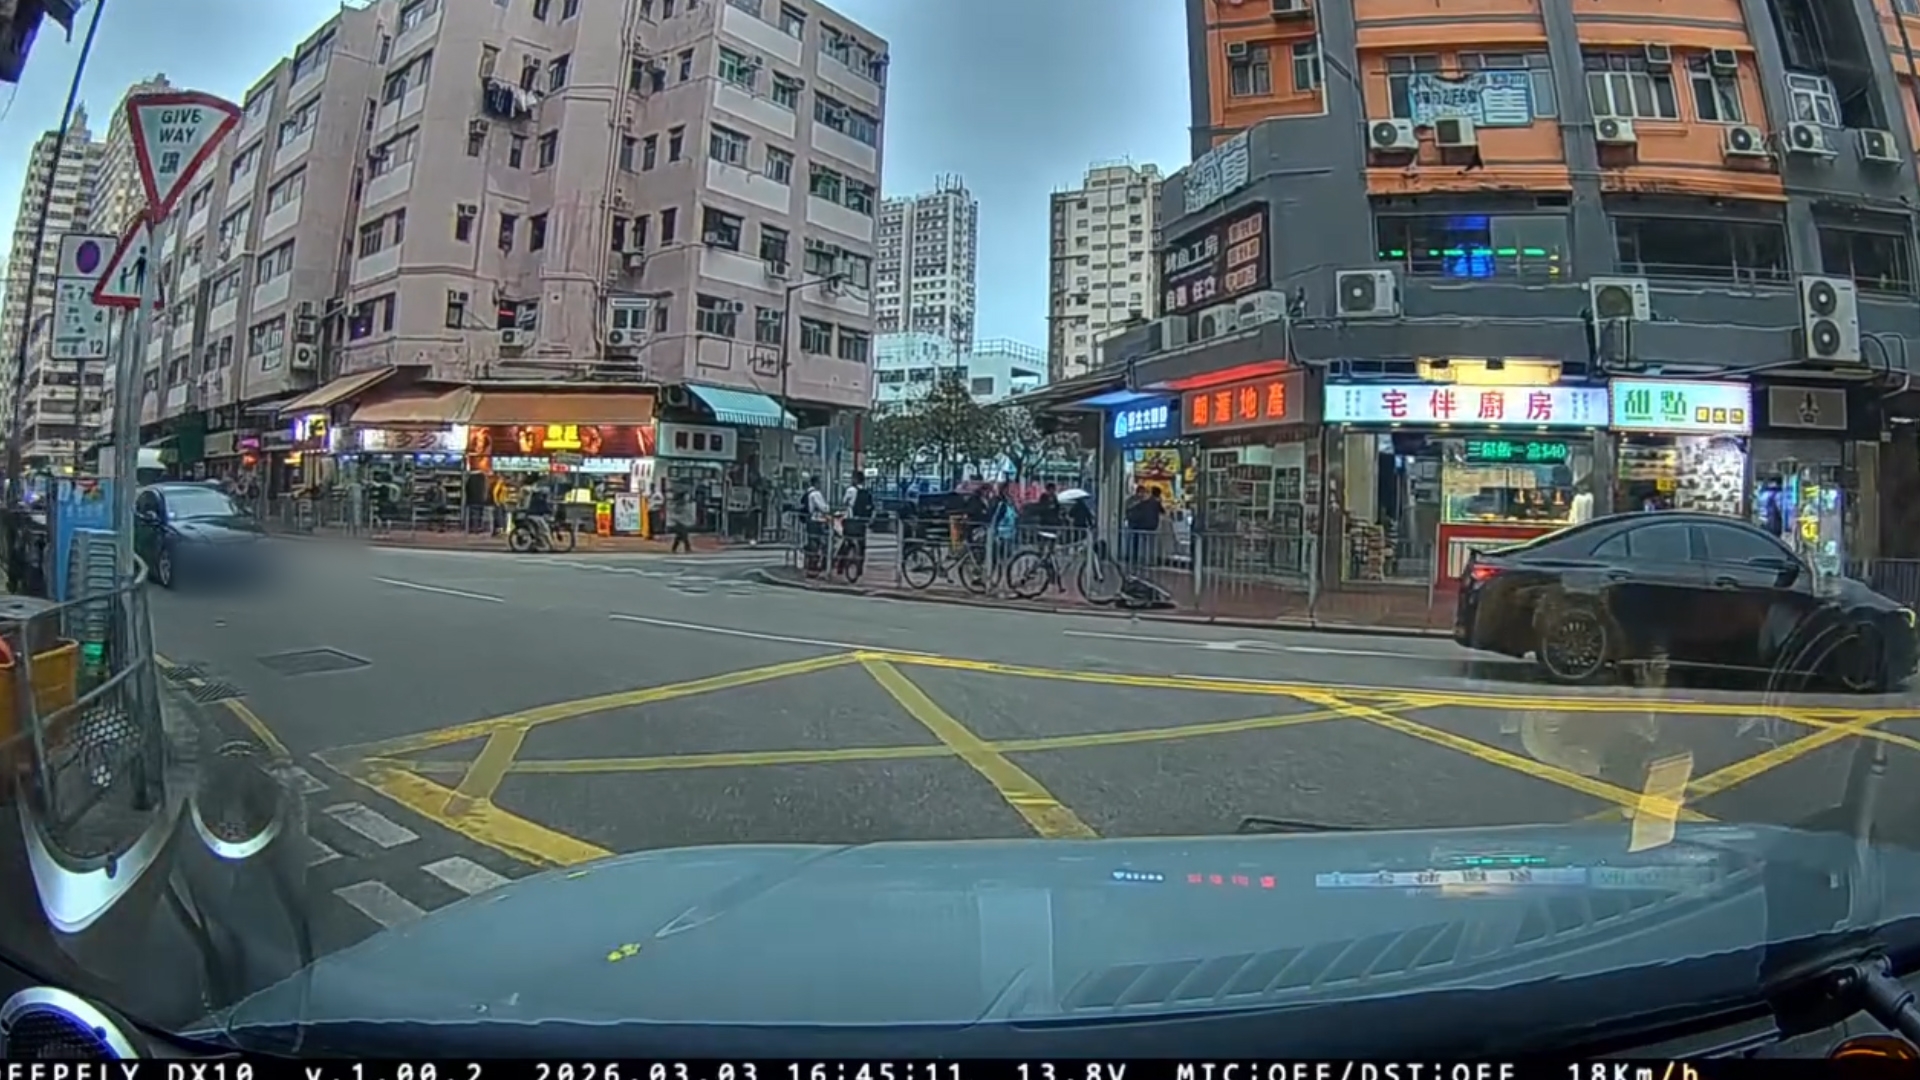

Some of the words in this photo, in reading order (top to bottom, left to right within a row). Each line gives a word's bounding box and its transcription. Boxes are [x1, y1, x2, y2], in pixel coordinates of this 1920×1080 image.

[161, 109, 202, 124] GIVE
[160, 127, 196, 142] WAY
[1381, 389, 1553, 420] 宅伴廚房
[1624, 389, 1688, 415] 甜點
